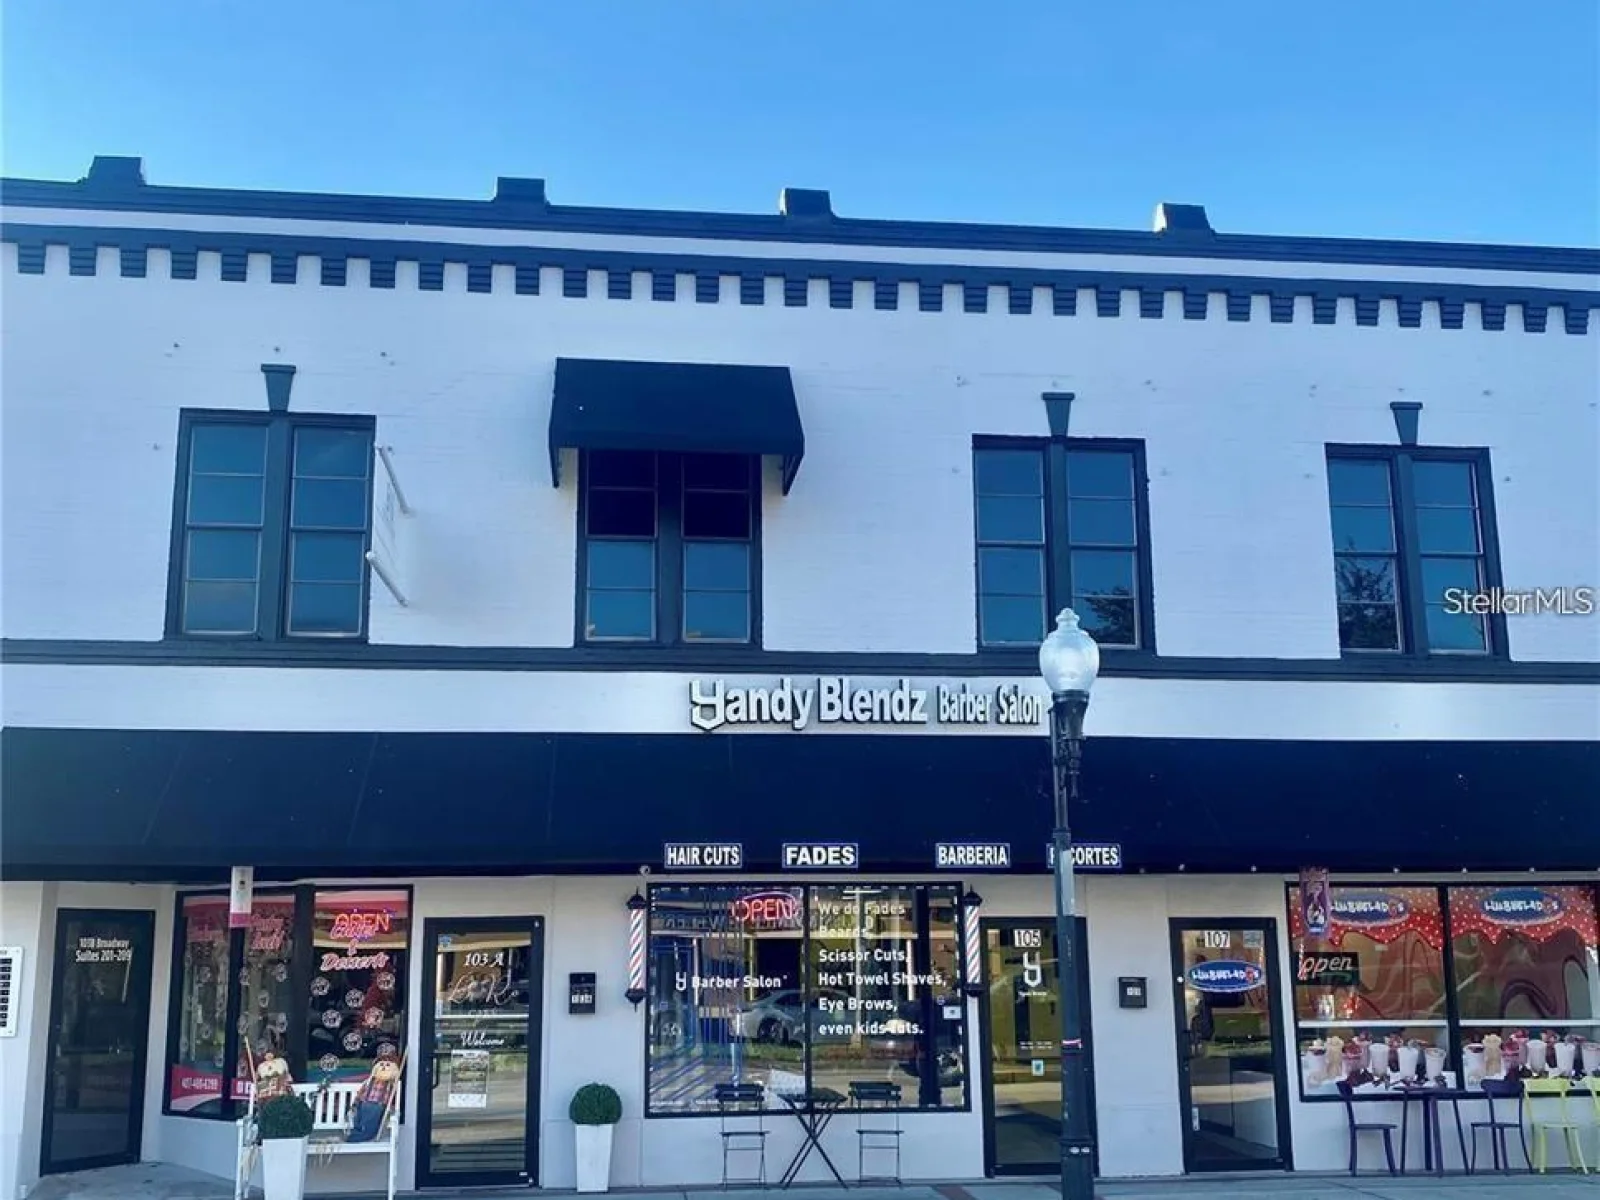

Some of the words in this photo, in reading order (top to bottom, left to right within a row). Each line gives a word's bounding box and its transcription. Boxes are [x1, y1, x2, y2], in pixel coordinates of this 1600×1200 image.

[689, 678, 814, 731] Yandy
[817, 677, 928, 725] Blendz
[937, 682, 993, 724] Barber
[996, 684, 1042, 724] Salon
[667, 846, 700, 865] HAIR
[703, 846, 740, 865] CUTS
[786, 846, 855, 866] FADES
[938, 846, 1008, 866] BARBERIA
[1049, 846, 1118, 866] CORTES
[731, 898, 794, 922] OPEN
[818, 902, 839, 915] We
[864, 901, 906, 915] Fades
[1014, 930, 1041, 947] 105
[1206, 931, 1230, 947] 107
[463, 953, 488, 967] 103
[489, 952, 504, 968] A
[819, 949, 871, 963] Scissor
[691, 975, 740, 988] Barber
[743, 975, 781, 988] Salon
[819, 972, 843, 986] Hot
[846, 972, 890, 986] Towel
[892, 972, 947, 988] Shaves,
[819, 998, 845, 1014] Eye
[847, 998, 898, 1012] Brows,
[819, 1023, 854, 1035] even
[856, 1020, 887, 1035] kids
[460, 1030, 505, 1047] Welcome
